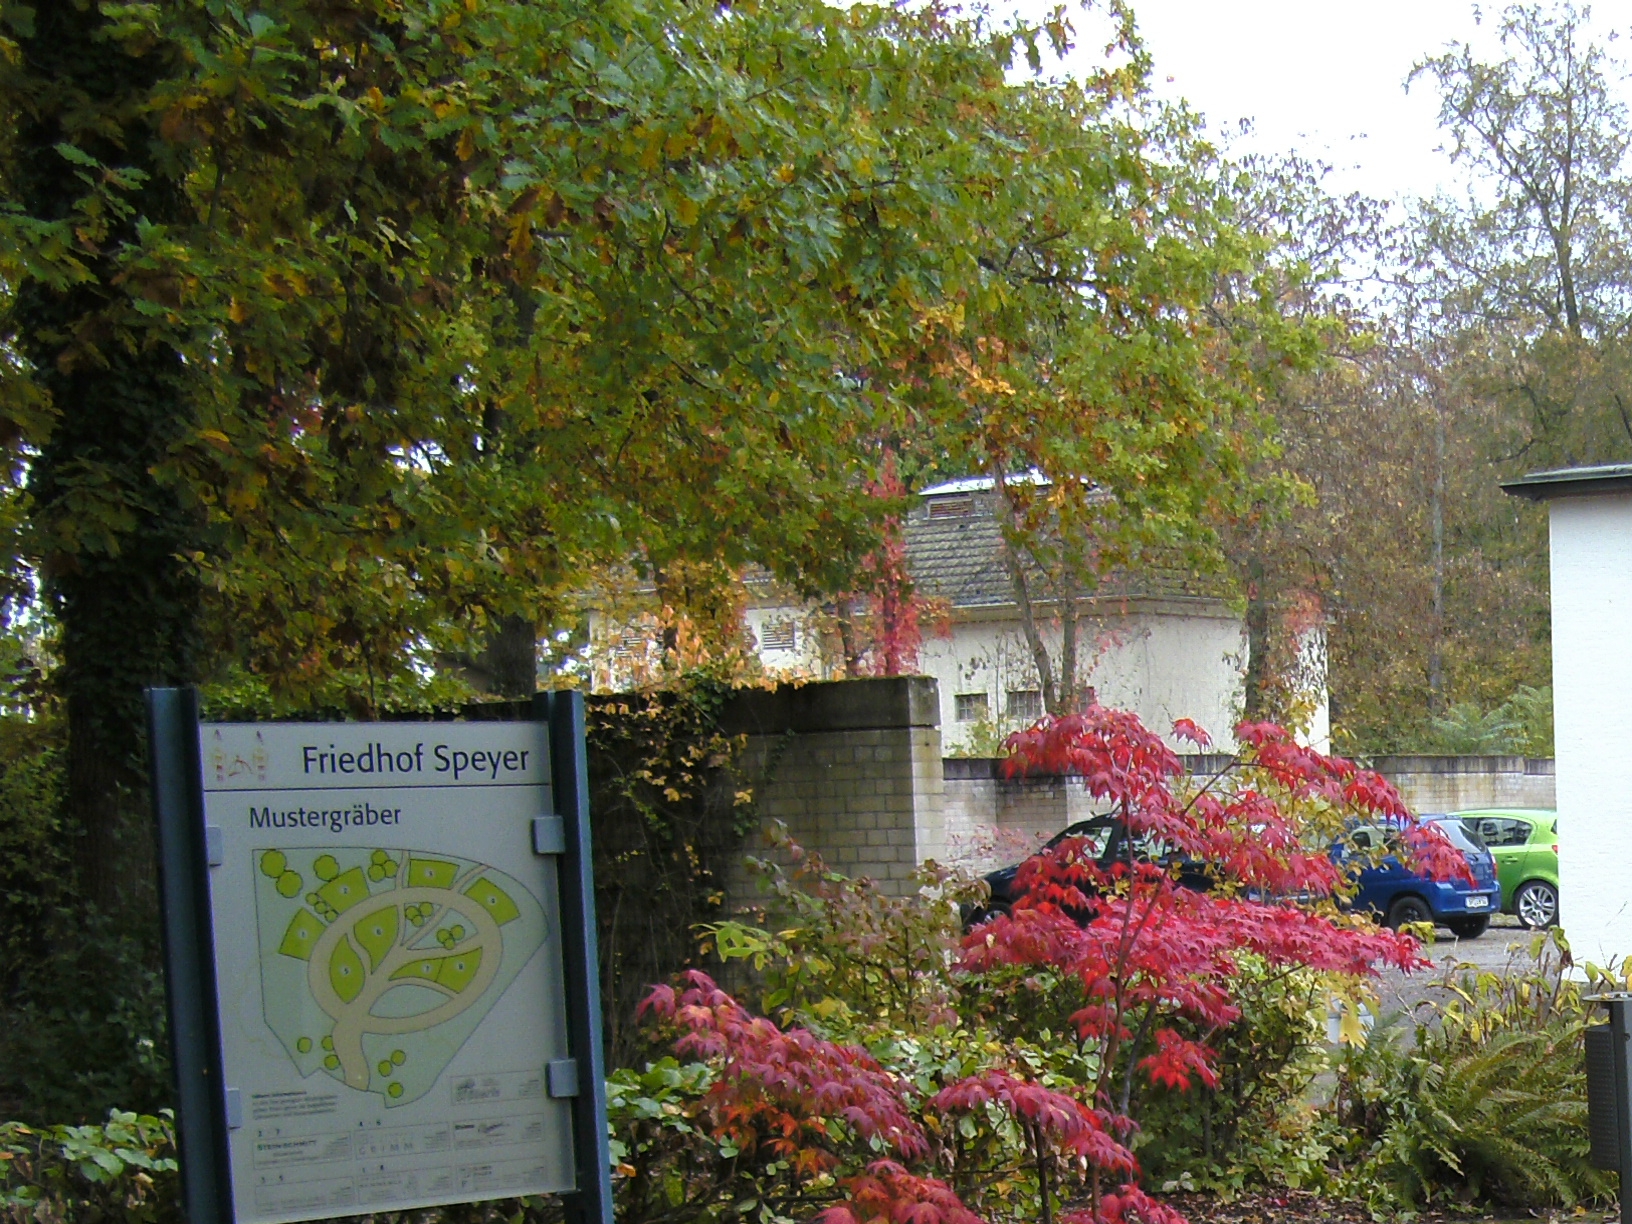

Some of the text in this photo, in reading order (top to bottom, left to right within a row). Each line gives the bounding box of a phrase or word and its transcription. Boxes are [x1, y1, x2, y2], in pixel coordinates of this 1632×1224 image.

[303, 743, 529, 780] Friedhof Speyer
[249, 803, 401, 832] Mustergräber
